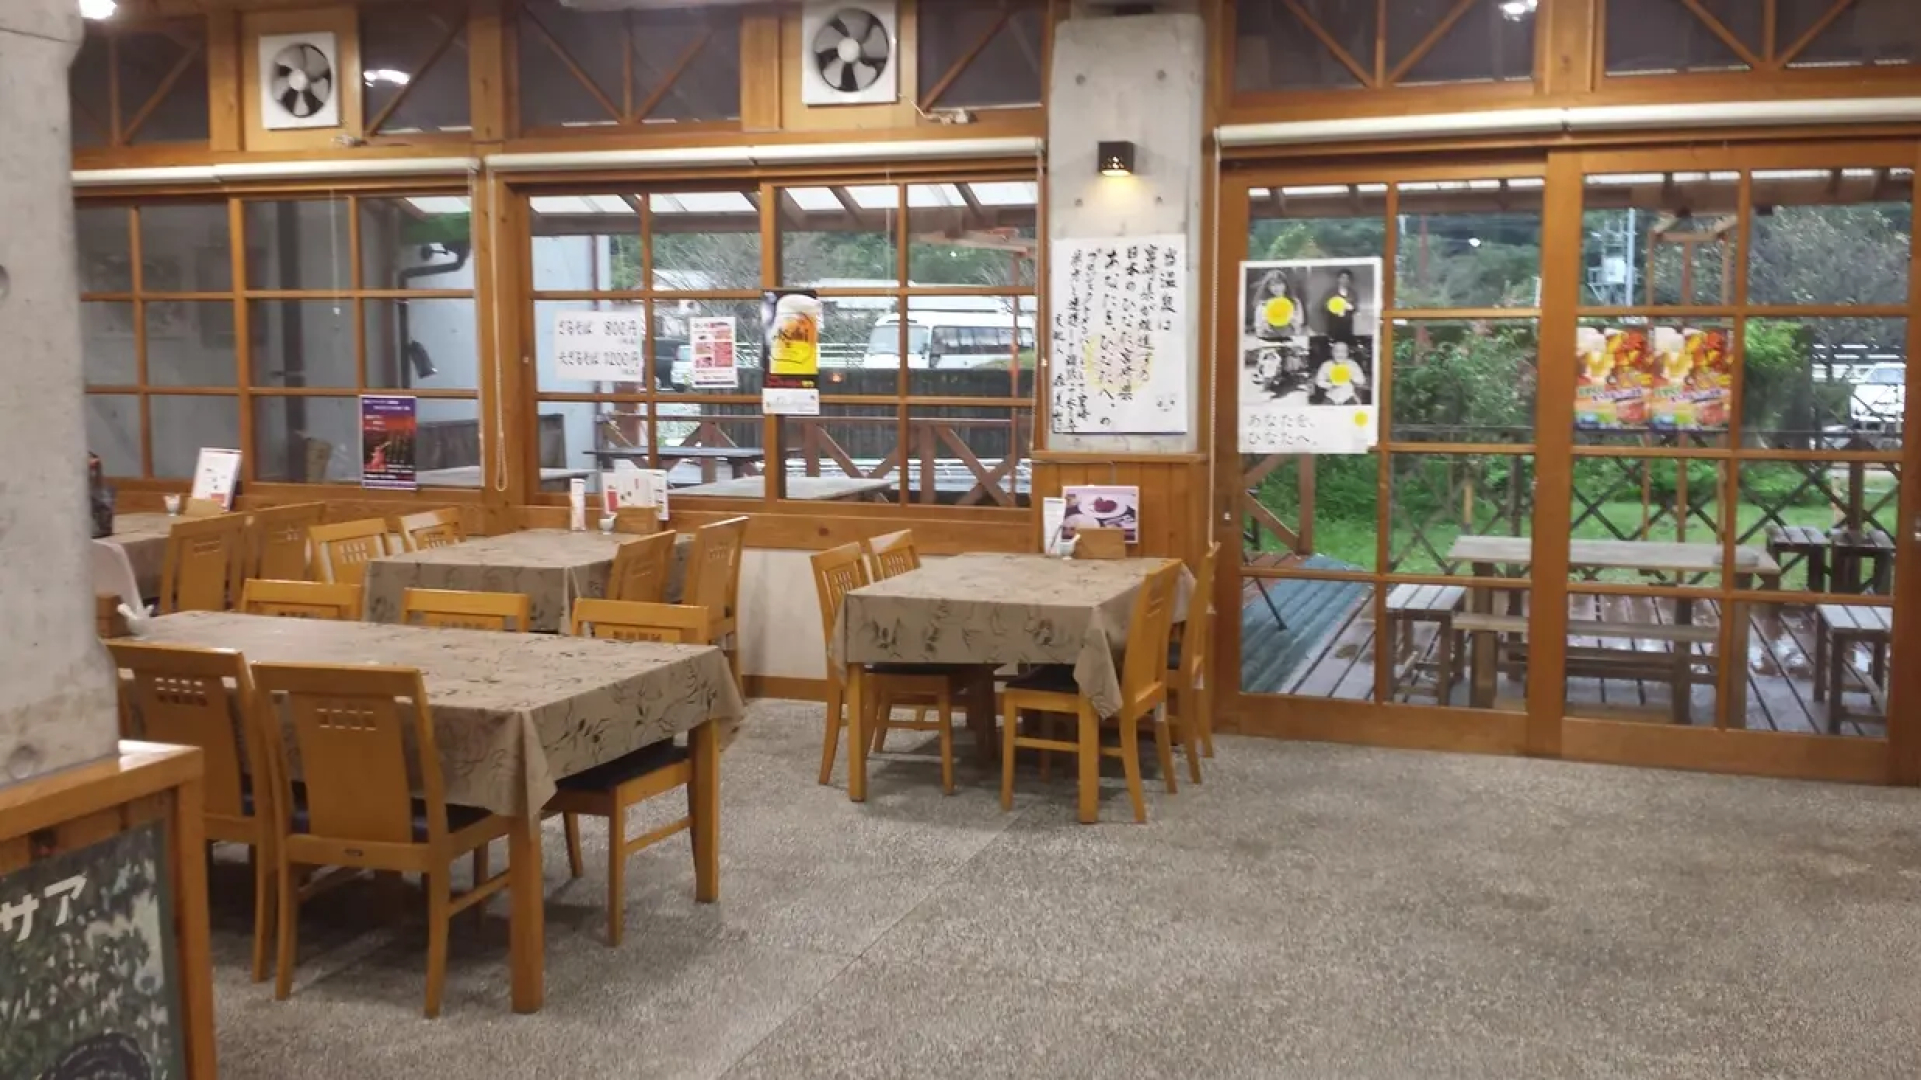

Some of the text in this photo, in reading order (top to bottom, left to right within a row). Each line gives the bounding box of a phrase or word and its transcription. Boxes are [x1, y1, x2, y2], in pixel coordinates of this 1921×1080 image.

[1248, 414, 1315, 428] あなたを、
[1248, 431, 1318, 445] ひなたへ。
